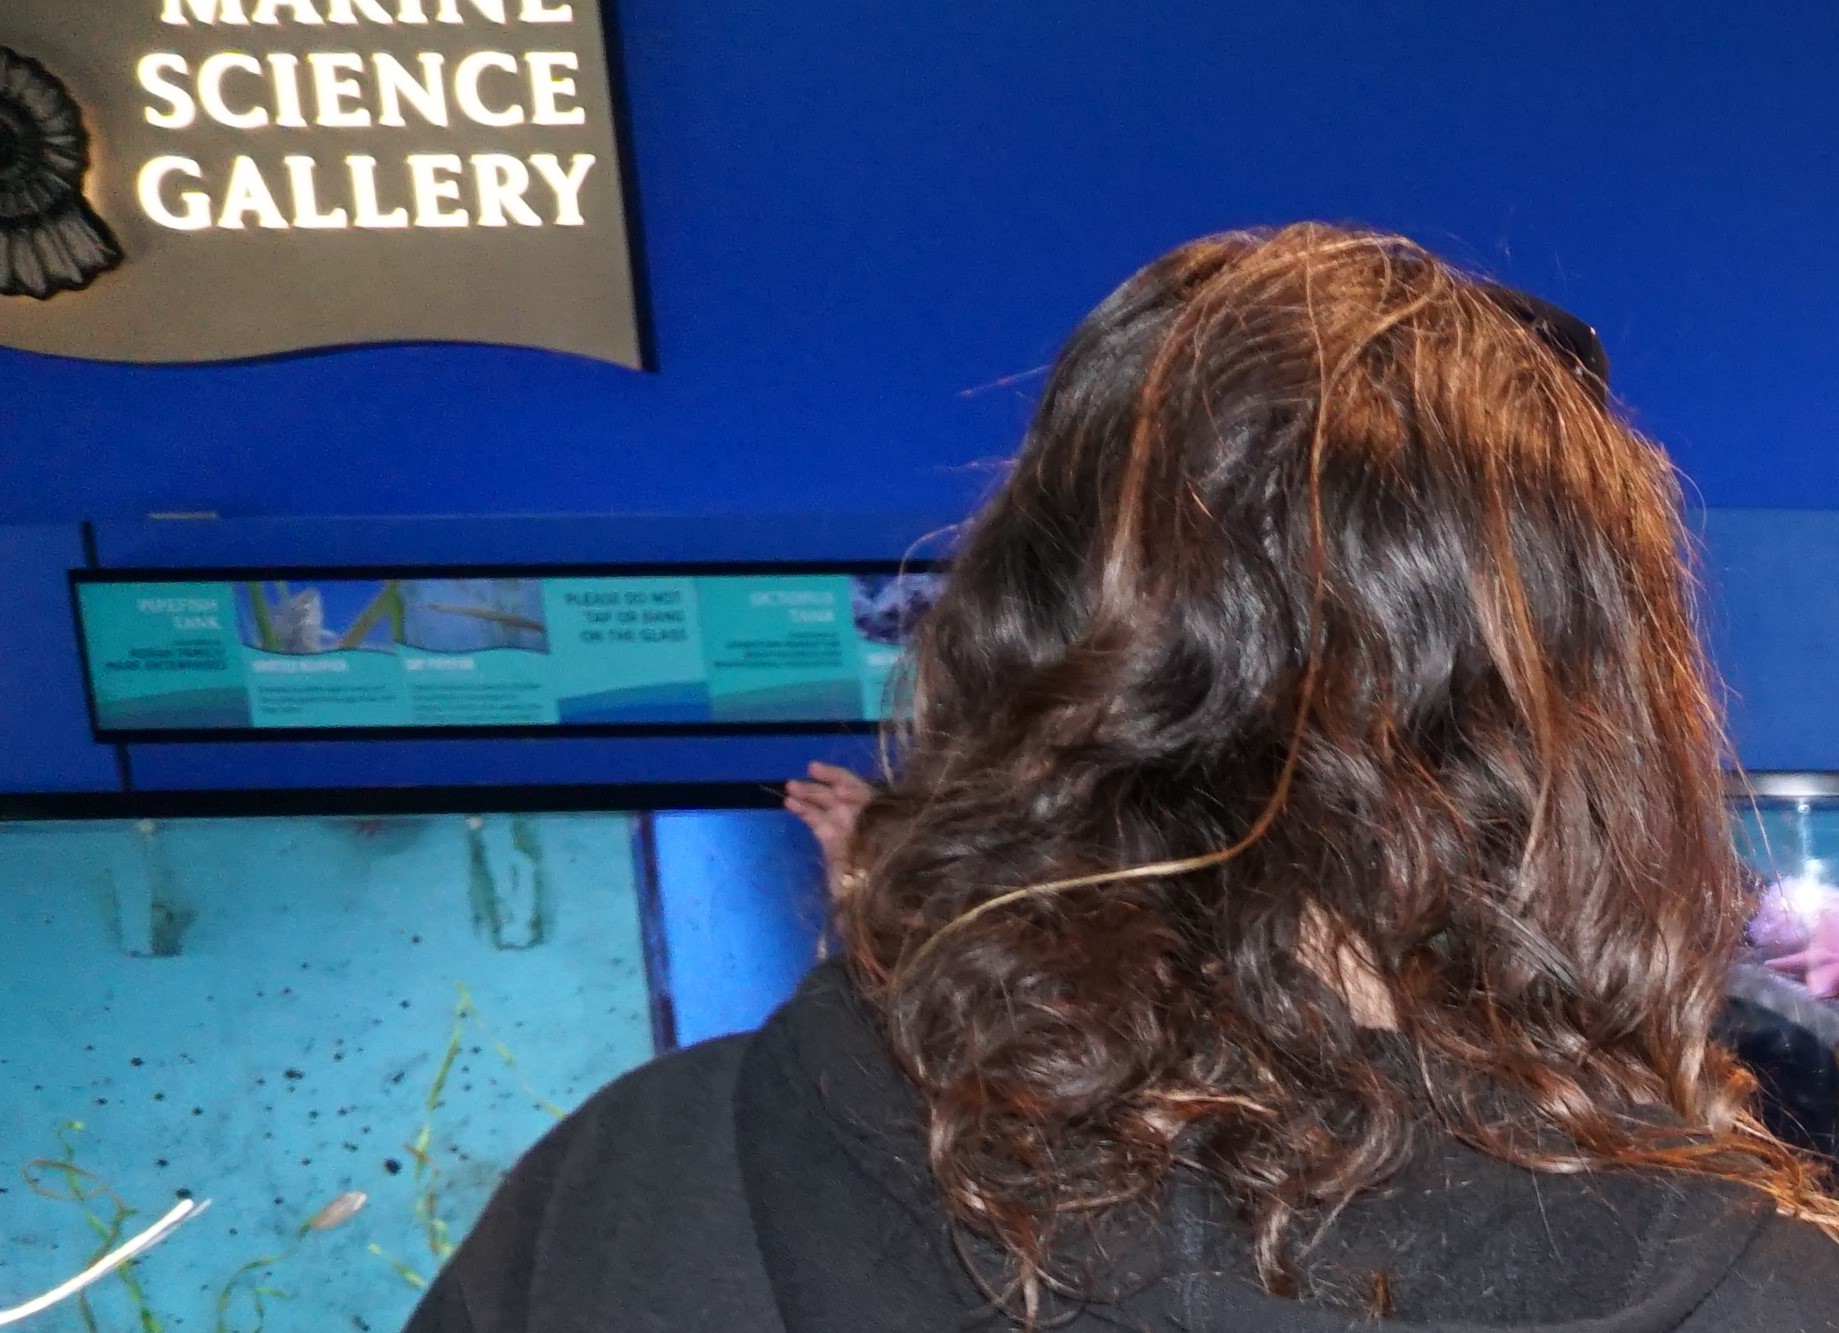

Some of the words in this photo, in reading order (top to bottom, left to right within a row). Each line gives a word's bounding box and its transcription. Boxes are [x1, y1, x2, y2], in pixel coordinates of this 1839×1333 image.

[135, 50, 587, 130] SCIENCE
[135, 152, 597, 231] GALLERY
[624, 591, 647, 605] DO
